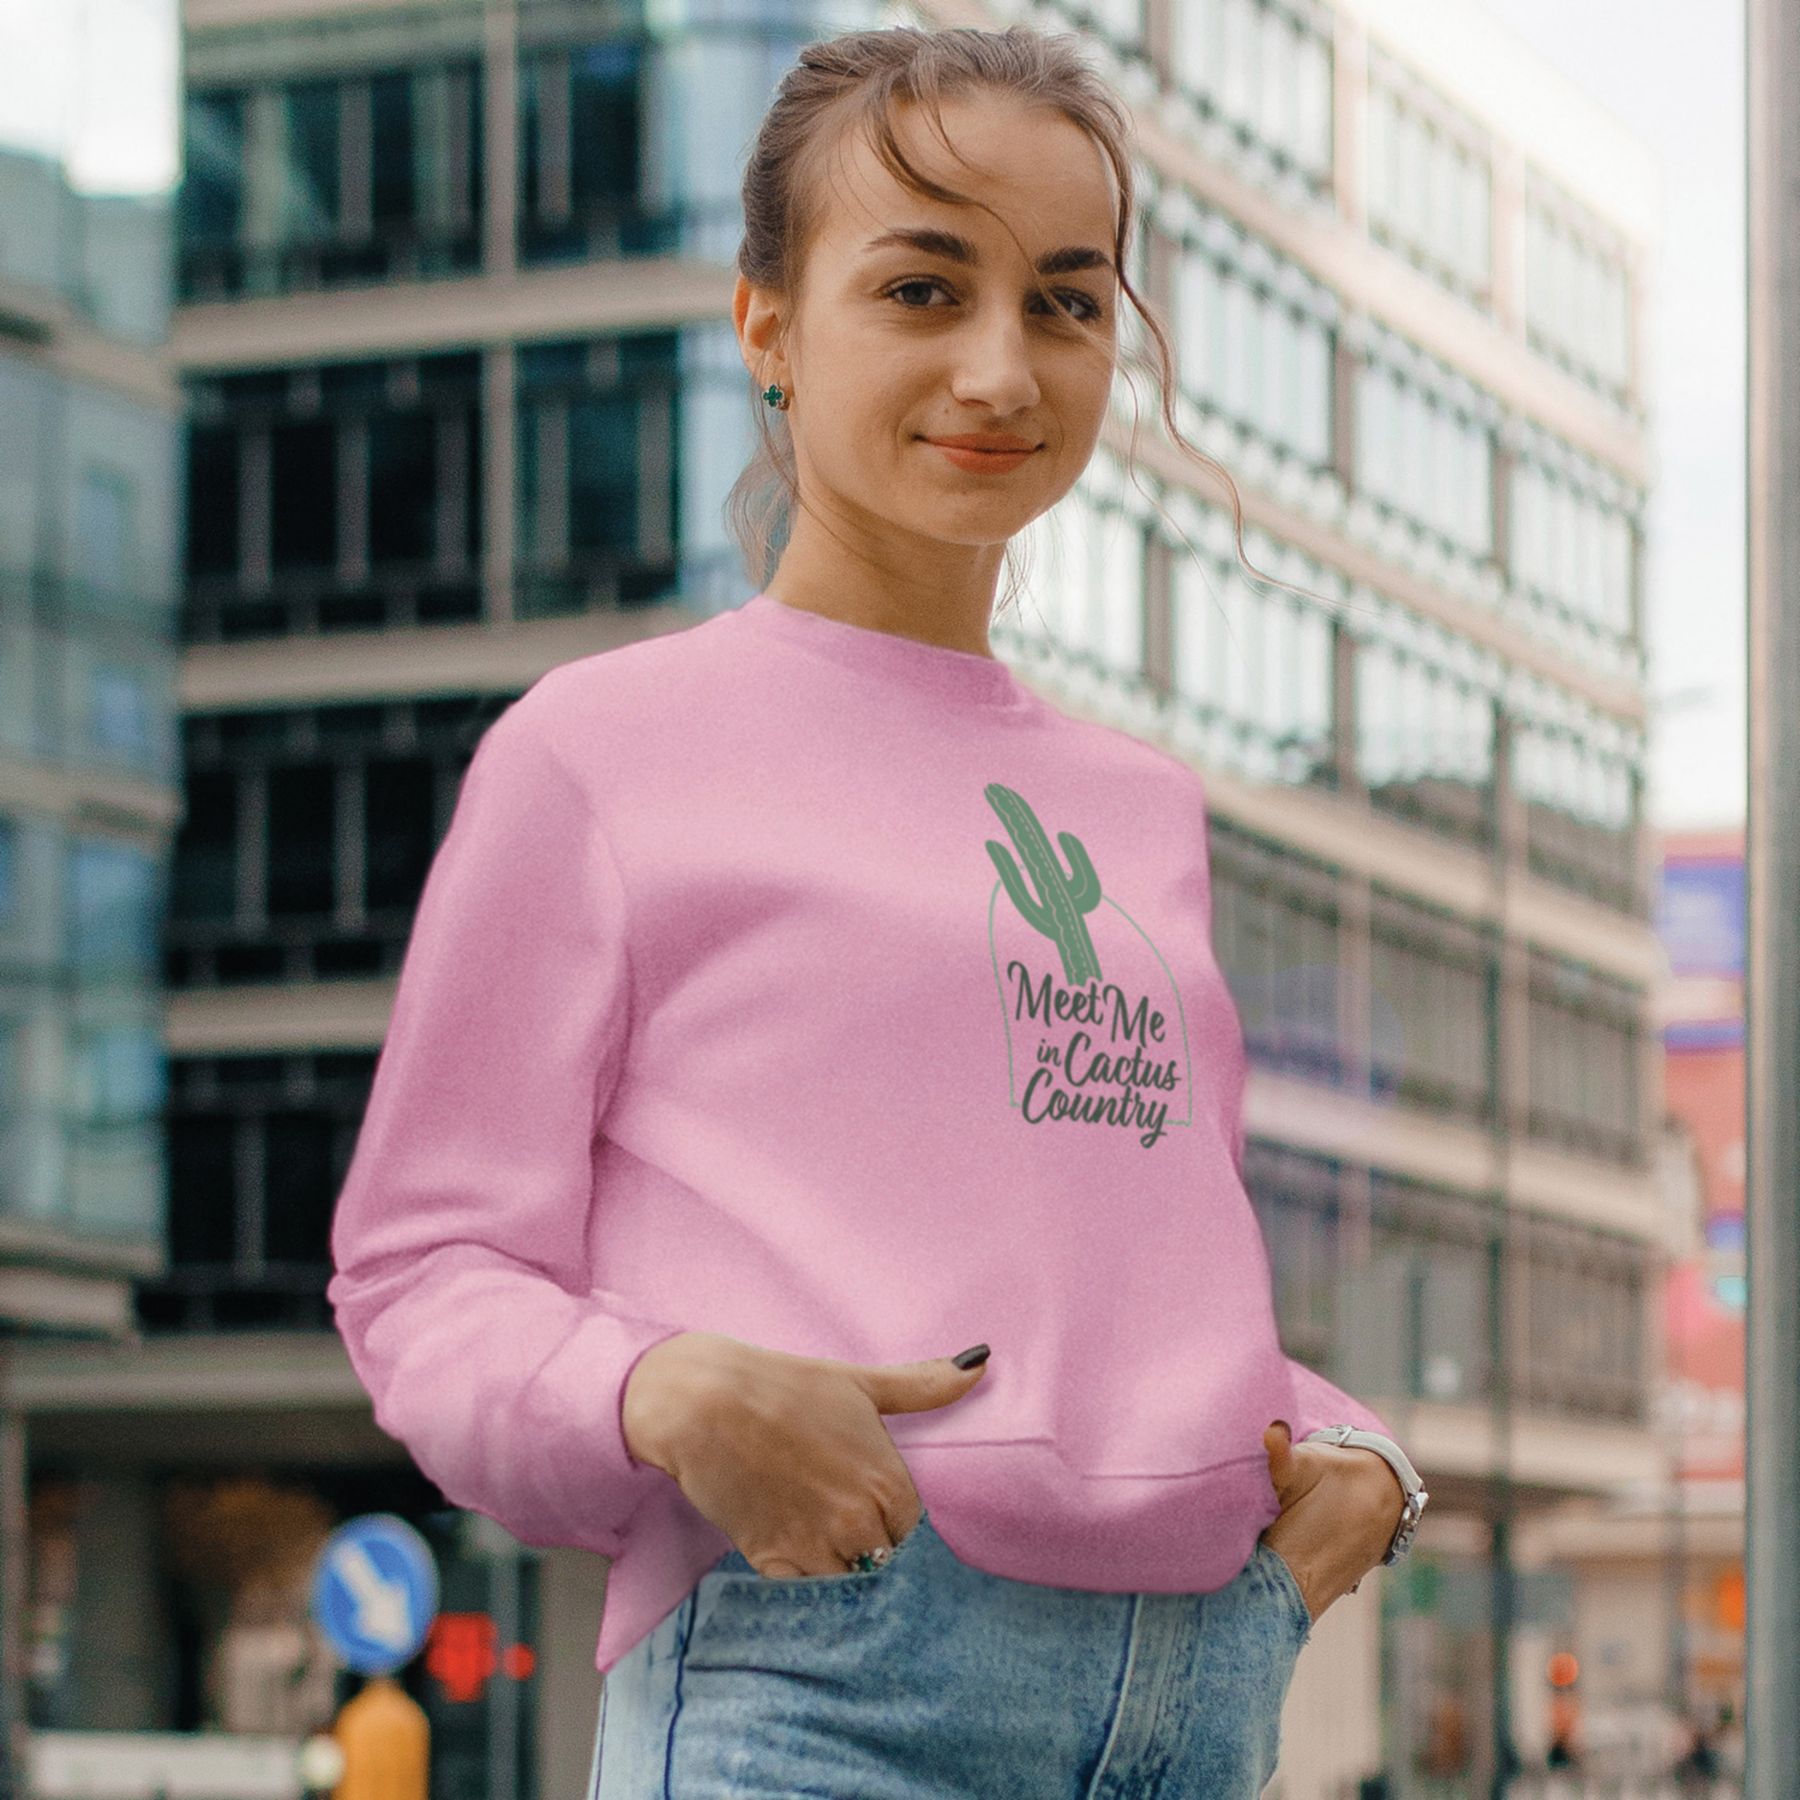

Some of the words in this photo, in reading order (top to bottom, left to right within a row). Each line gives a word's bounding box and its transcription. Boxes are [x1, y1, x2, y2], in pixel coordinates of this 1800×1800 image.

[1007, 960, 1104, 1028] Meet
[1102, 984, 1166, 1048] Me
[1036, 1038, 1061, 1067] in
[1064, 1031, 1182, 1091] Cactus
[1022, 1067, 1168, 1149] Country
